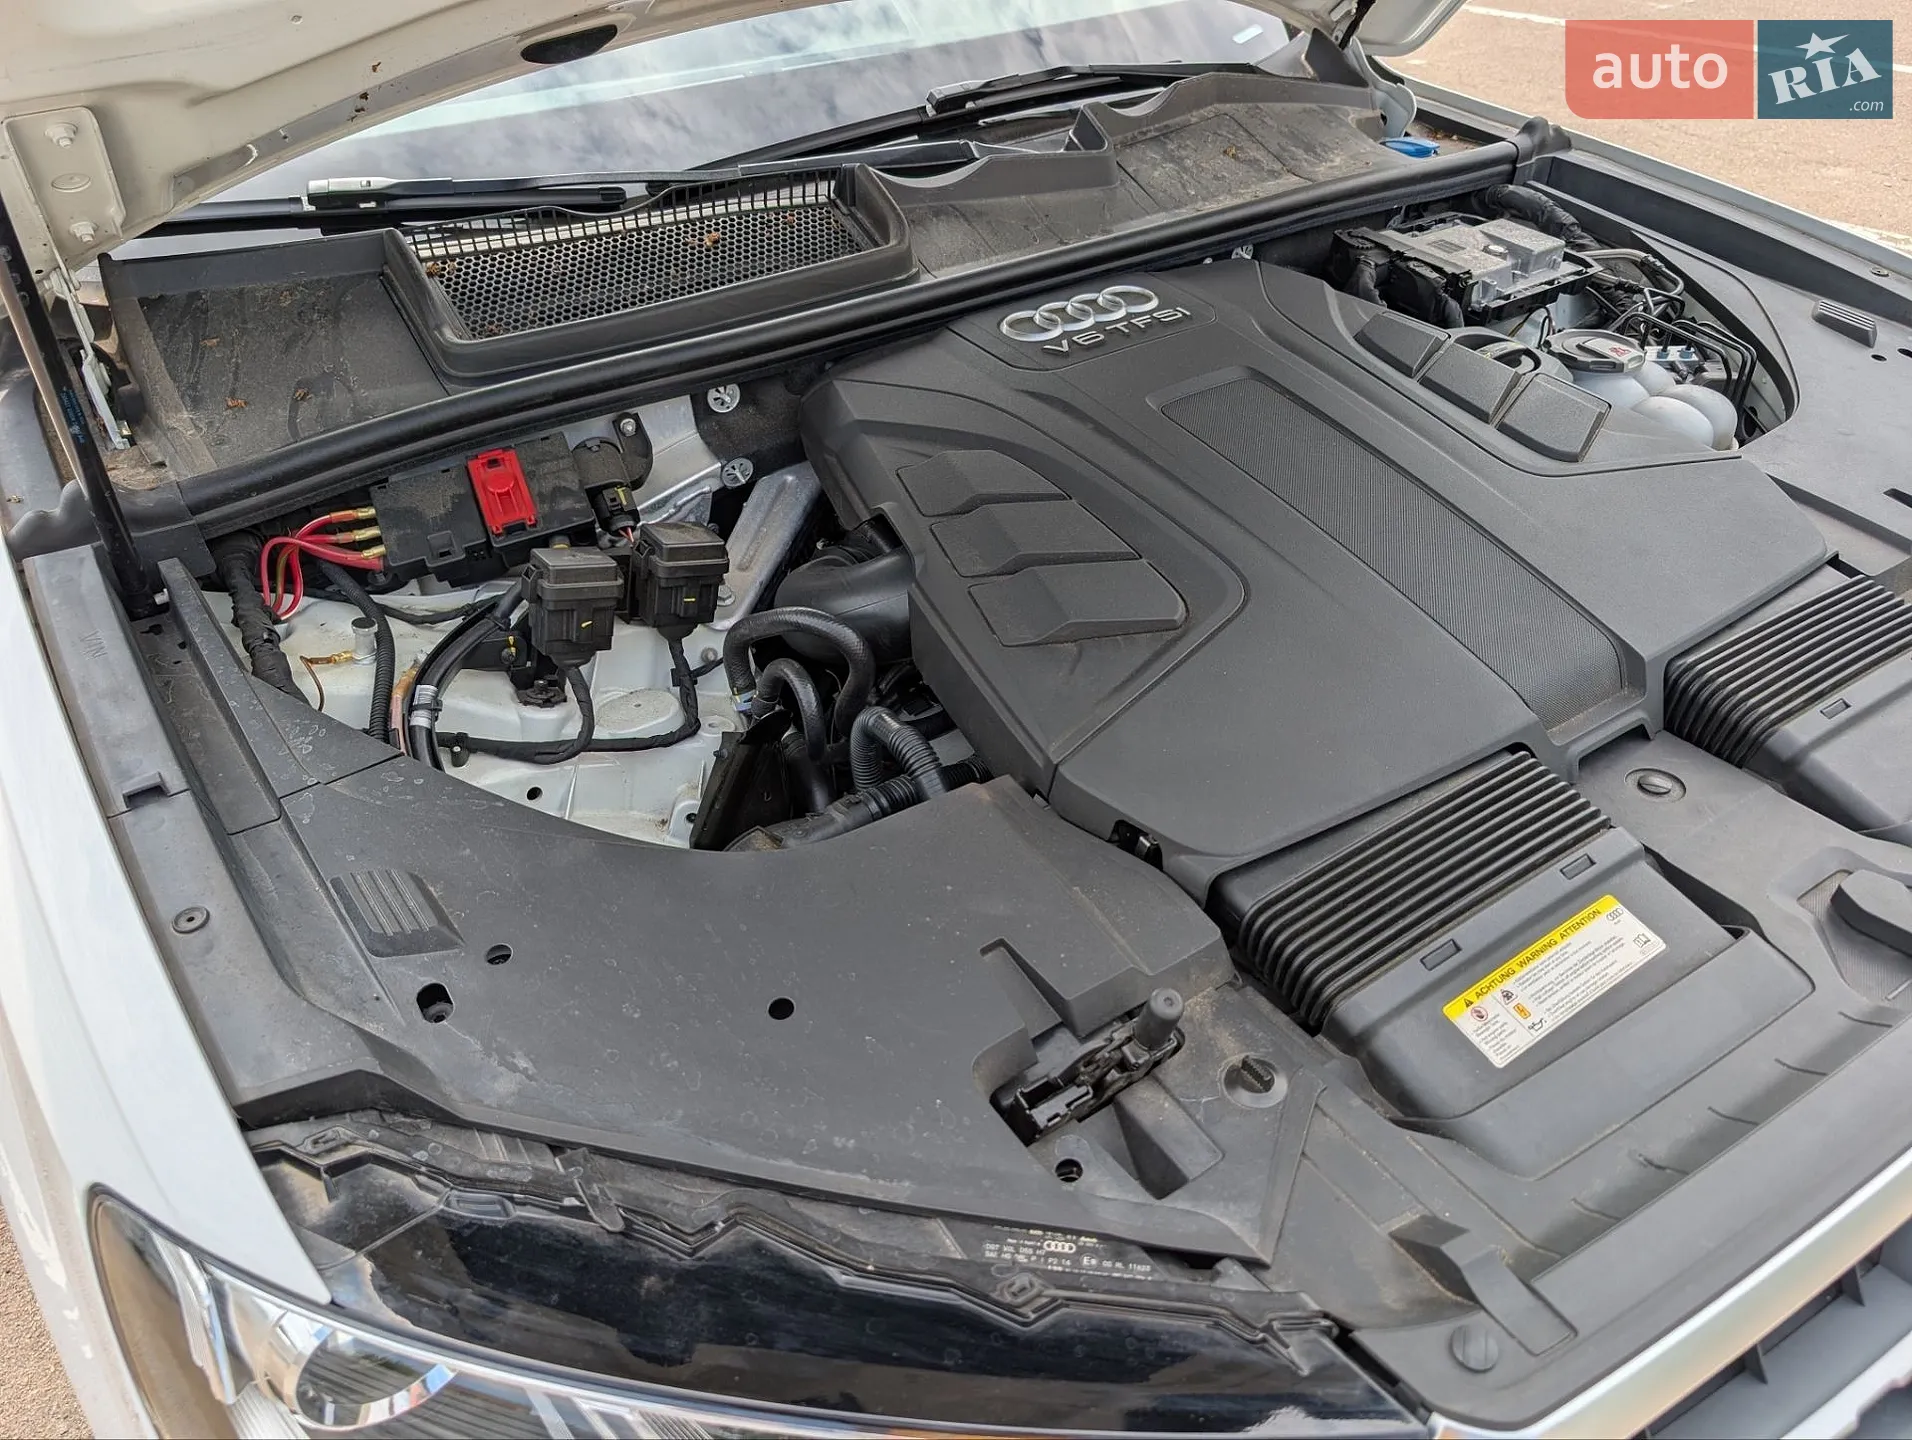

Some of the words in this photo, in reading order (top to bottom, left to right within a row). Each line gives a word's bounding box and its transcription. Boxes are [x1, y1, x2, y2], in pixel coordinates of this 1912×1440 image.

[1042, 330, 1105, 353] V6
[1105, 307, 1192, 334] TFSI
[1474, 967, 1516, 1000] ACHTUNG
[1516, 938, 1558, 969] WARNING
[1558, 908, 1602, 940] ATTENTION
